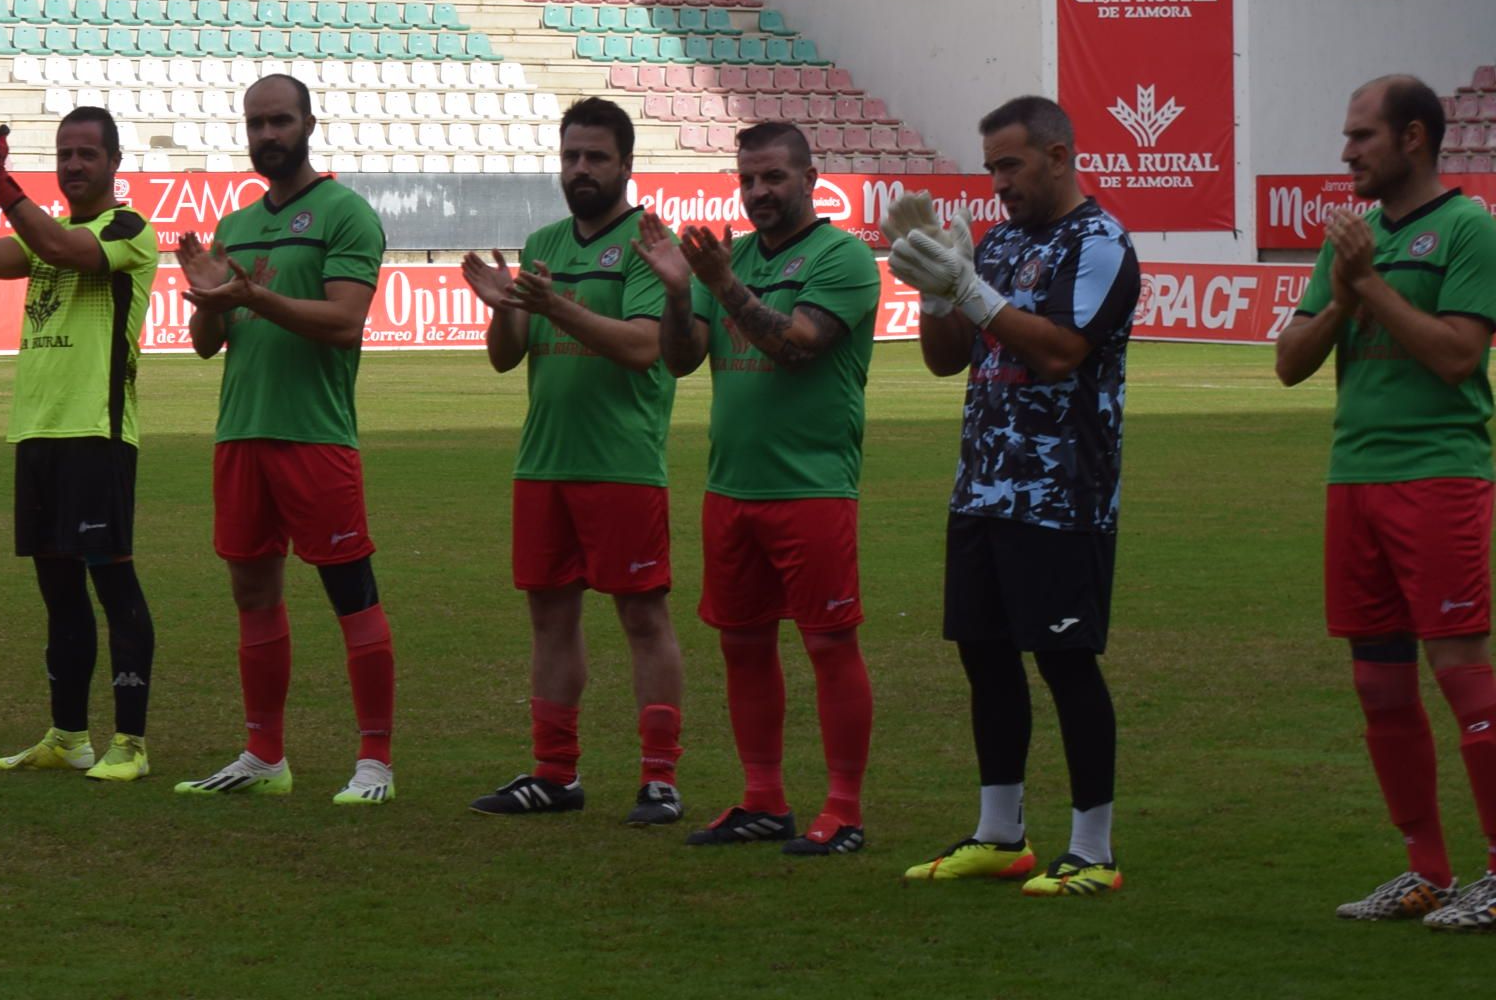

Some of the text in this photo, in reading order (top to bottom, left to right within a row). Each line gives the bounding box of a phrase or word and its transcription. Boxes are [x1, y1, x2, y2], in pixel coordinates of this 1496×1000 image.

[1098, 6, 1192, 18] DE ZAMORA
[1074, 153, 1219, 173] CAJA RURAL
[1100, 176, 1194, 188] DE ZAMORA
[156, 328, 176, 344] de
[426, 326, 445, 341] de
[32, 335, 74, 349] RURAL
